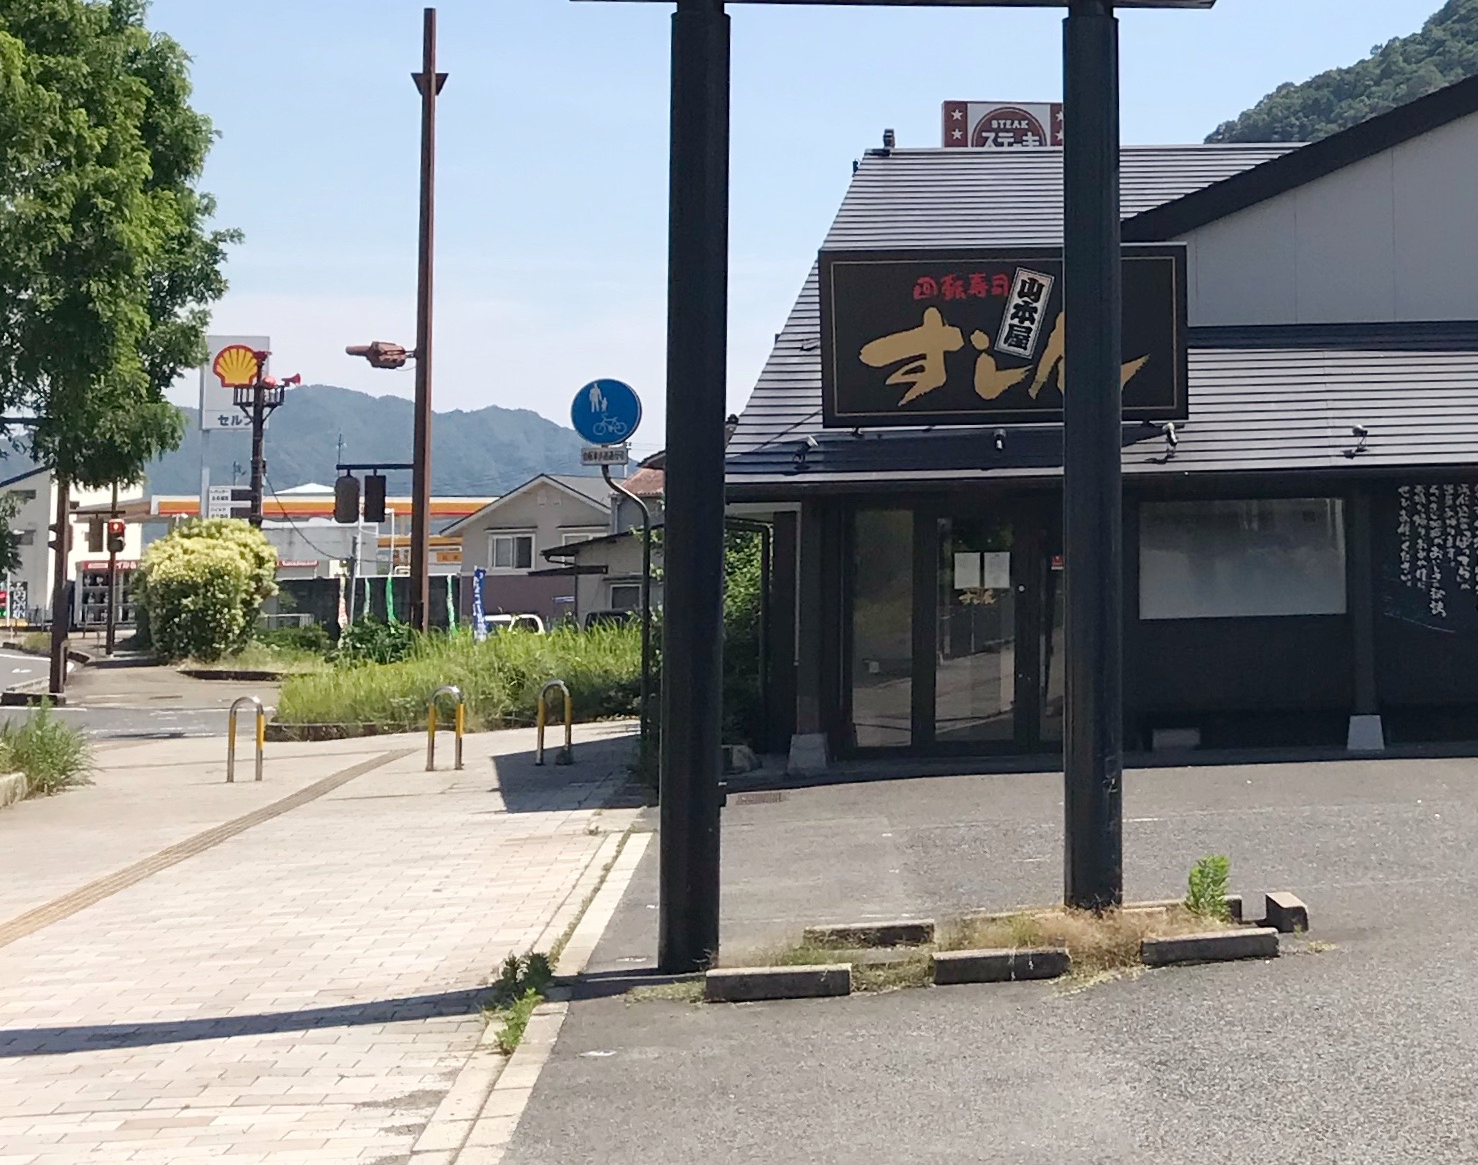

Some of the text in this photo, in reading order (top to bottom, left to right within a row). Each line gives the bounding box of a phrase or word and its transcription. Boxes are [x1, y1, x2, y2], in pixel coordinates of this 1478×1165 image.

[991, 120, 1029, 129] STEAK
[913, 271, 1011, 301] 回転寿司
[1003, 276, 1045, 352] 山本屋
